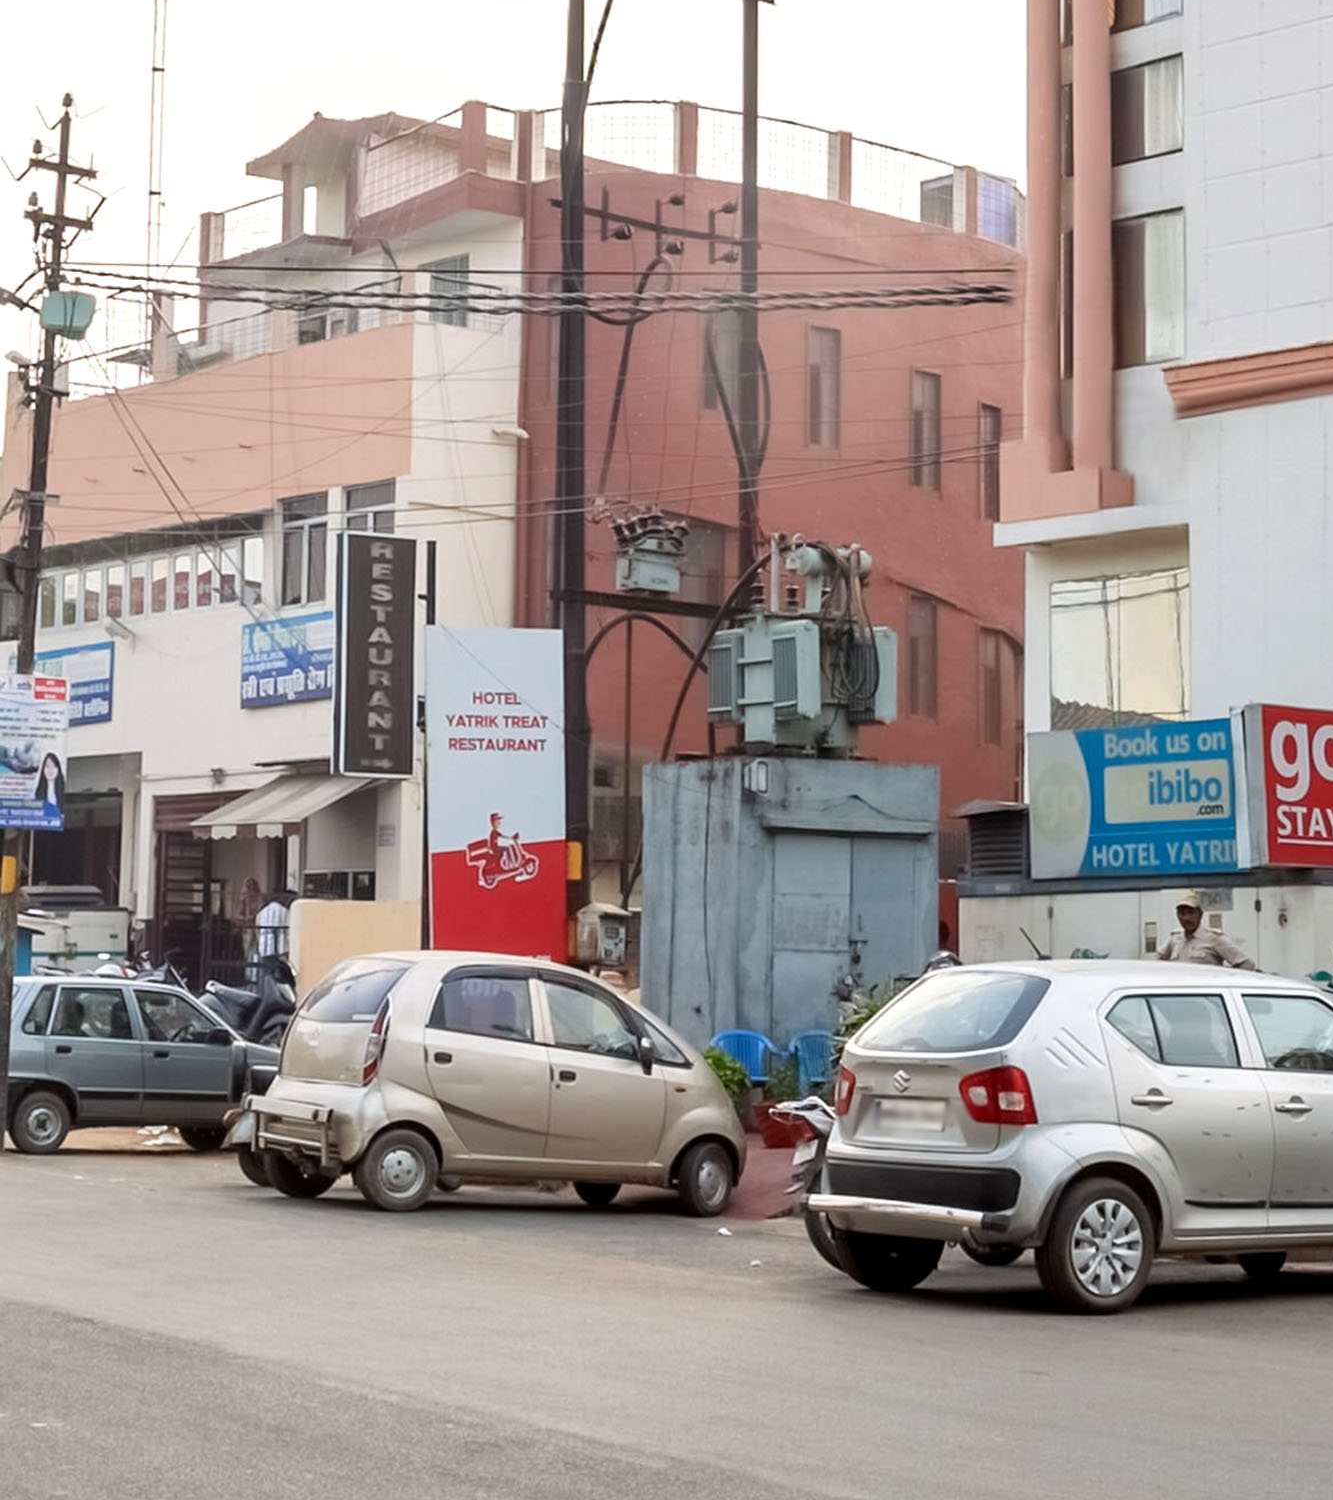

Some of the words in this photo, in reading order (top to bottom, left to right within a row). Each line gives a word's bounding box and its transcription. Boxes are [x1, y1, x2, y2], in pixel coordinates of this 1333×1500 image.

[369, 540, 395, 751] RESTAURANT
[472, 691, 522, 706] HOTEL
[446, 714, 499, 729] YATRIK
[502, 715, 549, 729] TREAT
[448, 737, 548, 752] RESTAURANT
[1103, 729, 1159, 759] Book
[1165, 733, 1190, 754] us
[1197, 731, 1227, 751] on
[1148, 768, 1223, 806] ibibo
[1196, 803, 1224, 816] .com
[1092, 842, 1160, 868] HOTEL
[1165, 838, 1239, 866] YATRI
